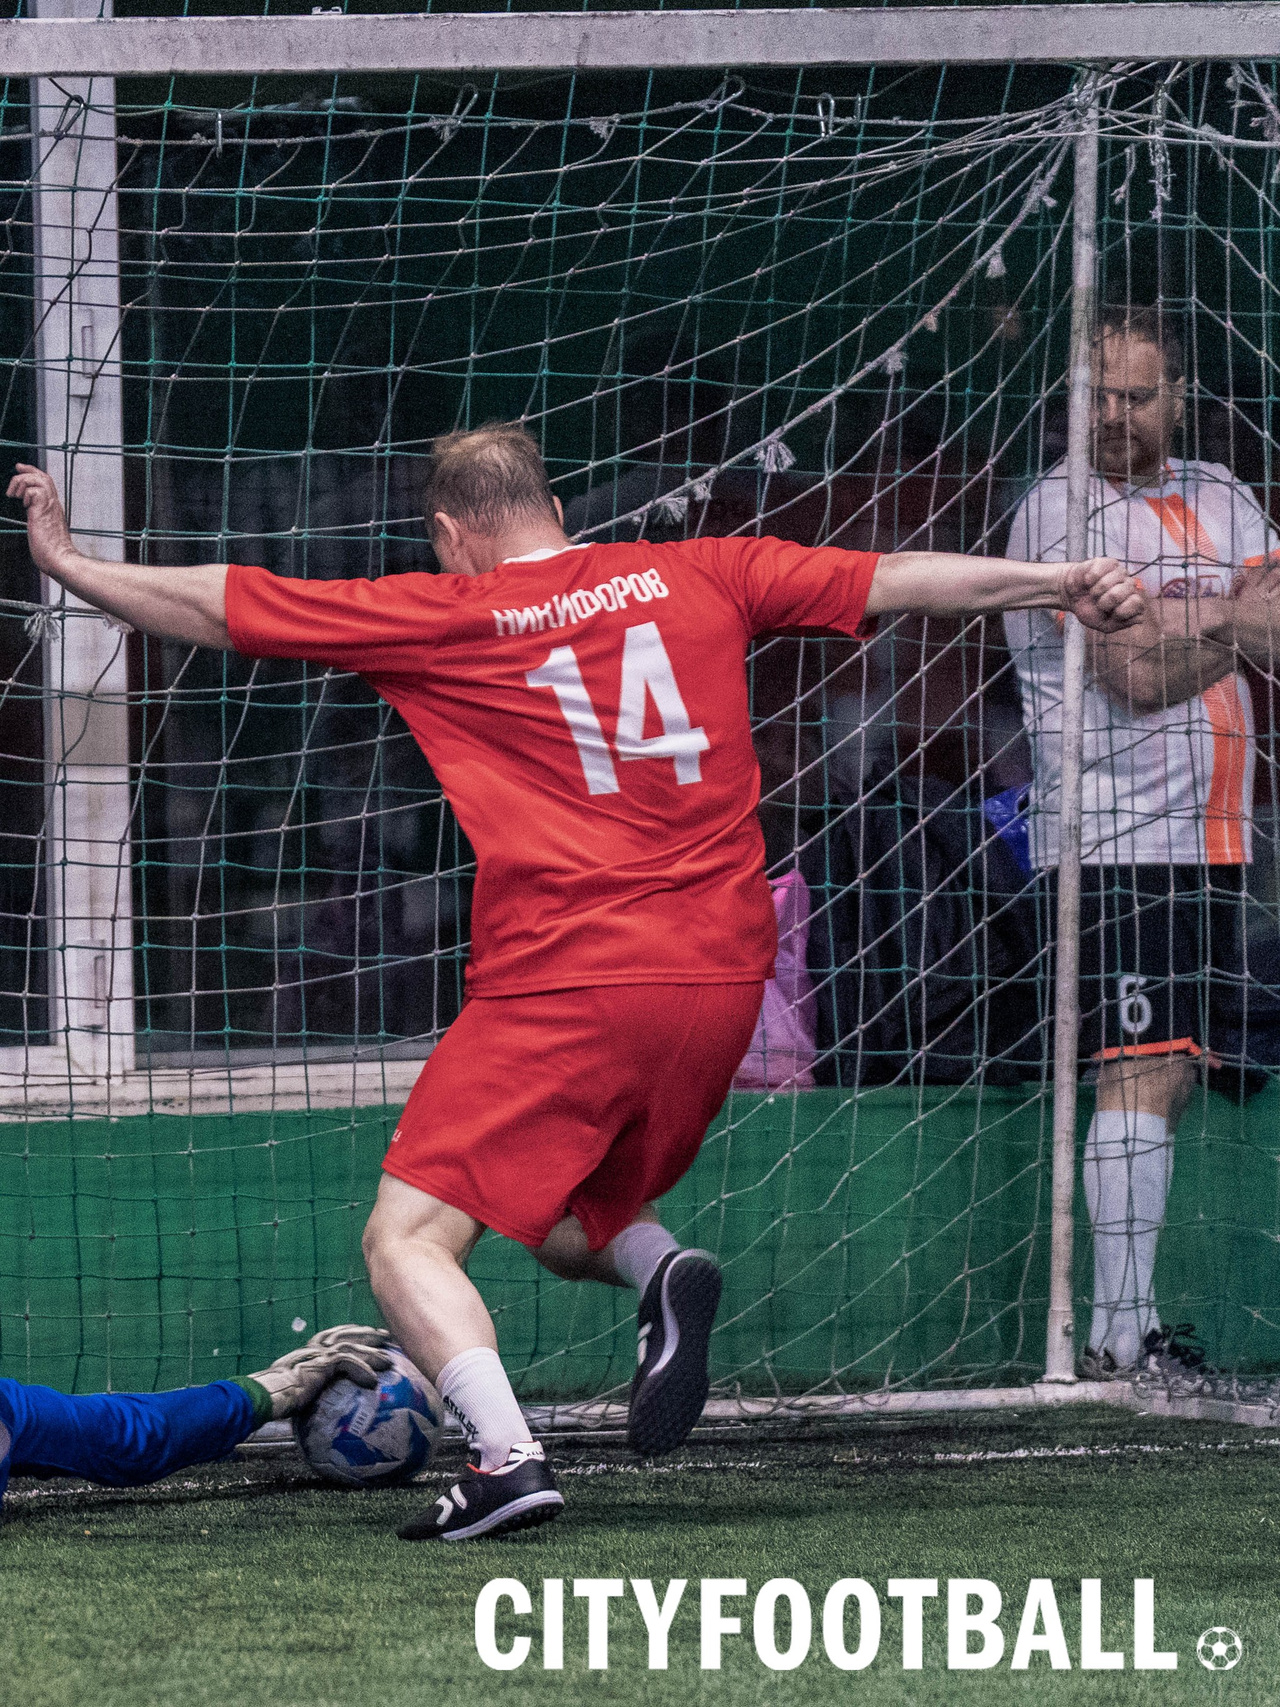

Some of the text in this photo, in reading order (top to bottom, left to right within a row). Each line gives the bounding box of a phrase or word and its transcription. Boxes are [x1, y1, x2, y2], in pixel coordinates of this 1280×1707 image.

[491, 567, 670, 637] НИКИФОРОВ
[526, 620, 711, 796] 14
[1118, 974, 1153, 1035] 6
[443, 1395, 479, 1439] ATHLEX
